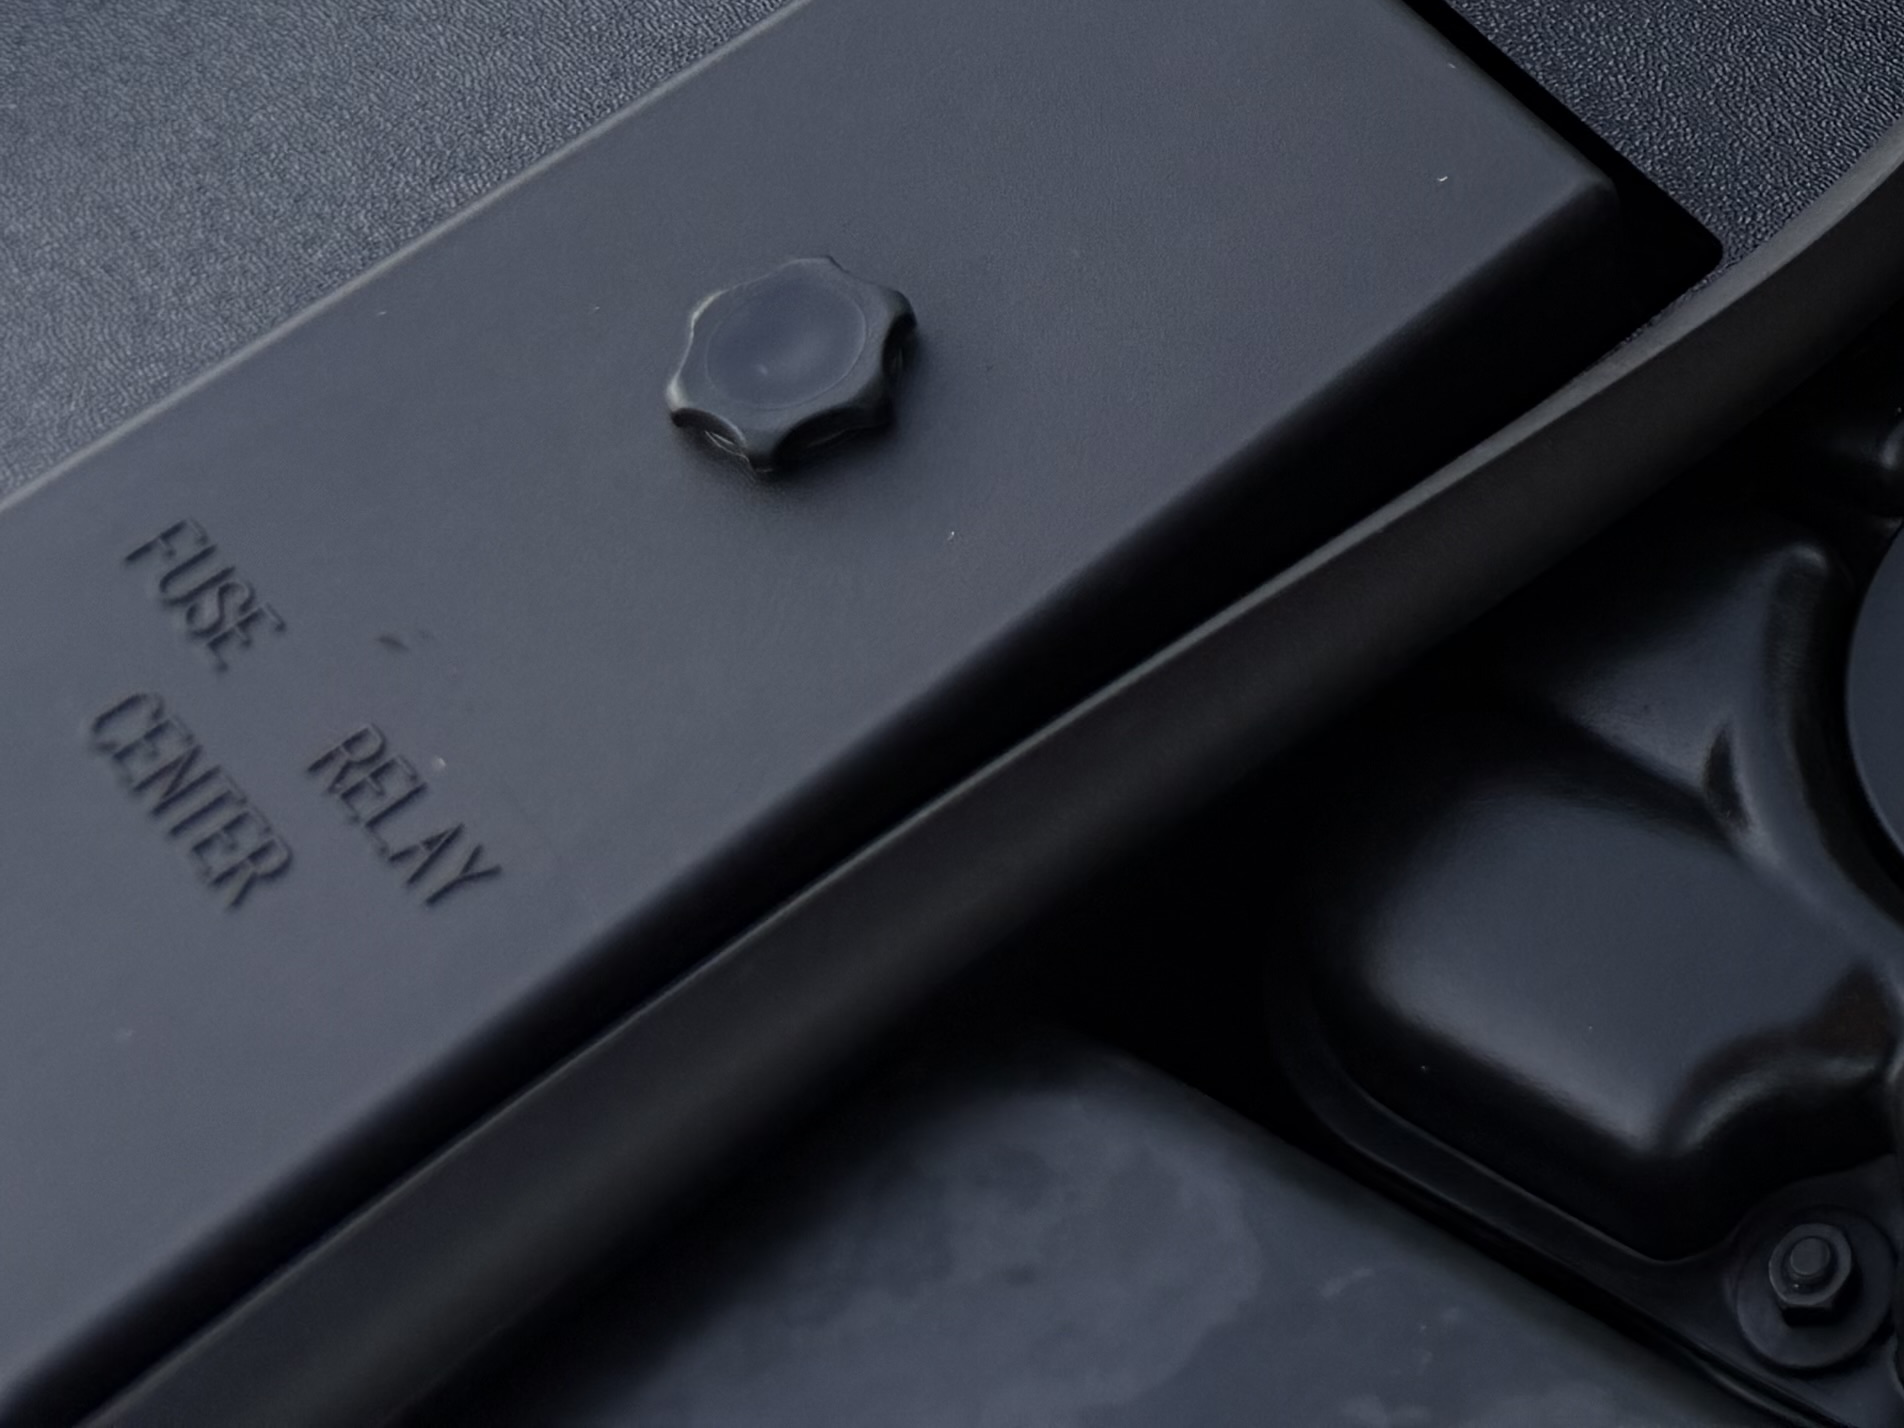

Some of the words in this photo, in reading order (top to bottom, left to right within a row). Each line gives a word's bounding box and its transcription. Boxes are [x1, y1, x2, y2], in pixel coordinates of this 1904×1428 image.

[84, 689, 297, 913] CENTER
[122, 517, 289, 674] FUSE
[304, 722, 503, 909] RELAY
